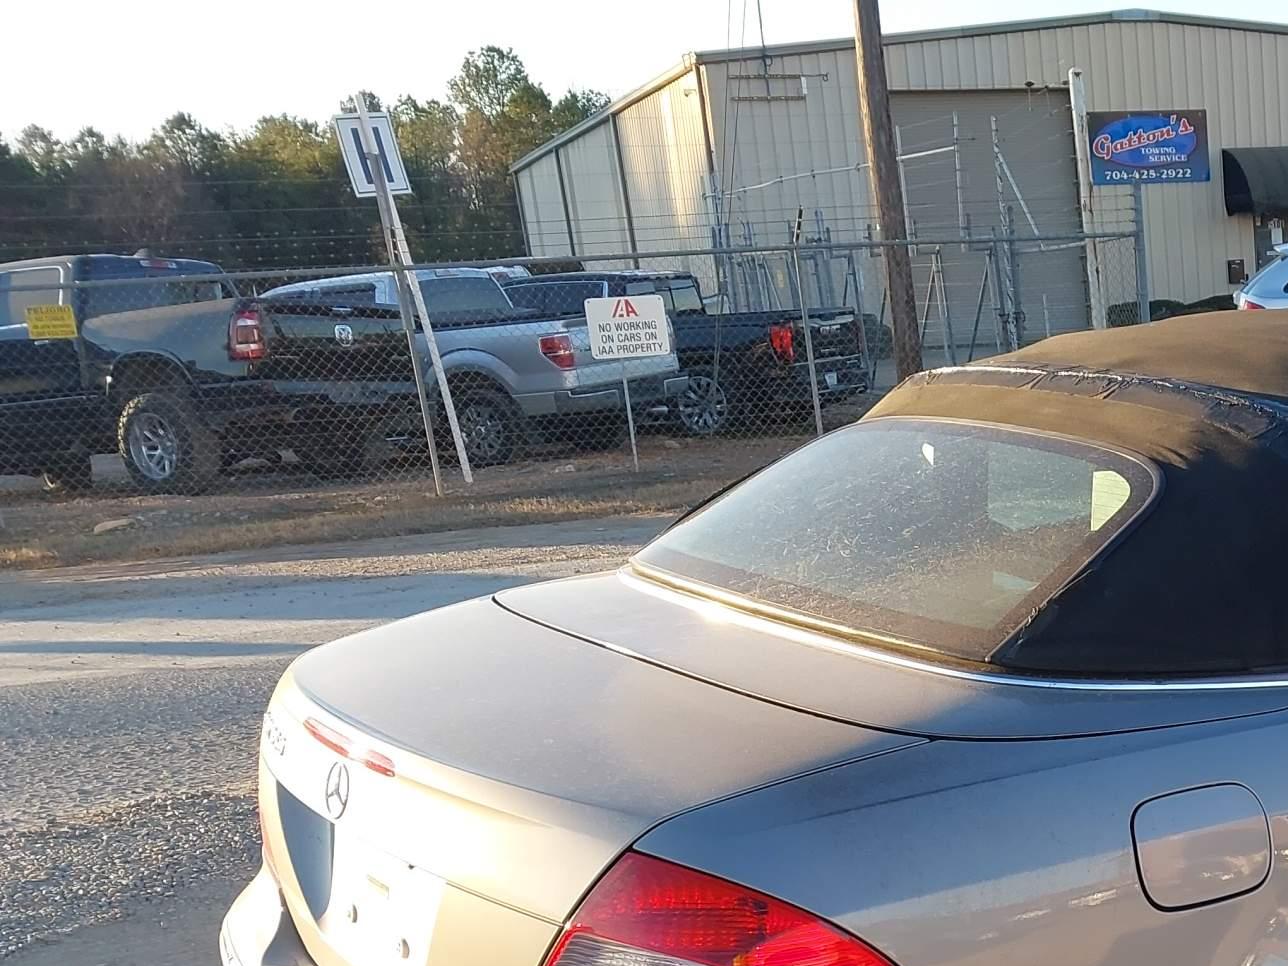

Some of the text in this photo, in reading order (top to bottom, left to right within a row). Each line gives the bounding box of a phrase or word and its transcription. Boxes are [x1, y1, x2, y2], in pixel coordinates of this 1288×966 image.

[1093, 113, 1194, 159] Gatton's
[1140, 146, 1176, 154] TOWING
[1148, 153, 1188, 162] SERVICE
[1104, 168, 1192, 180] 704-425-2922
[598, 320, 657, 332] NO WORKING
[601, 331, 657, 344] ON CARS ON
[598, 342, 663, 355] IAA PROPERTY
